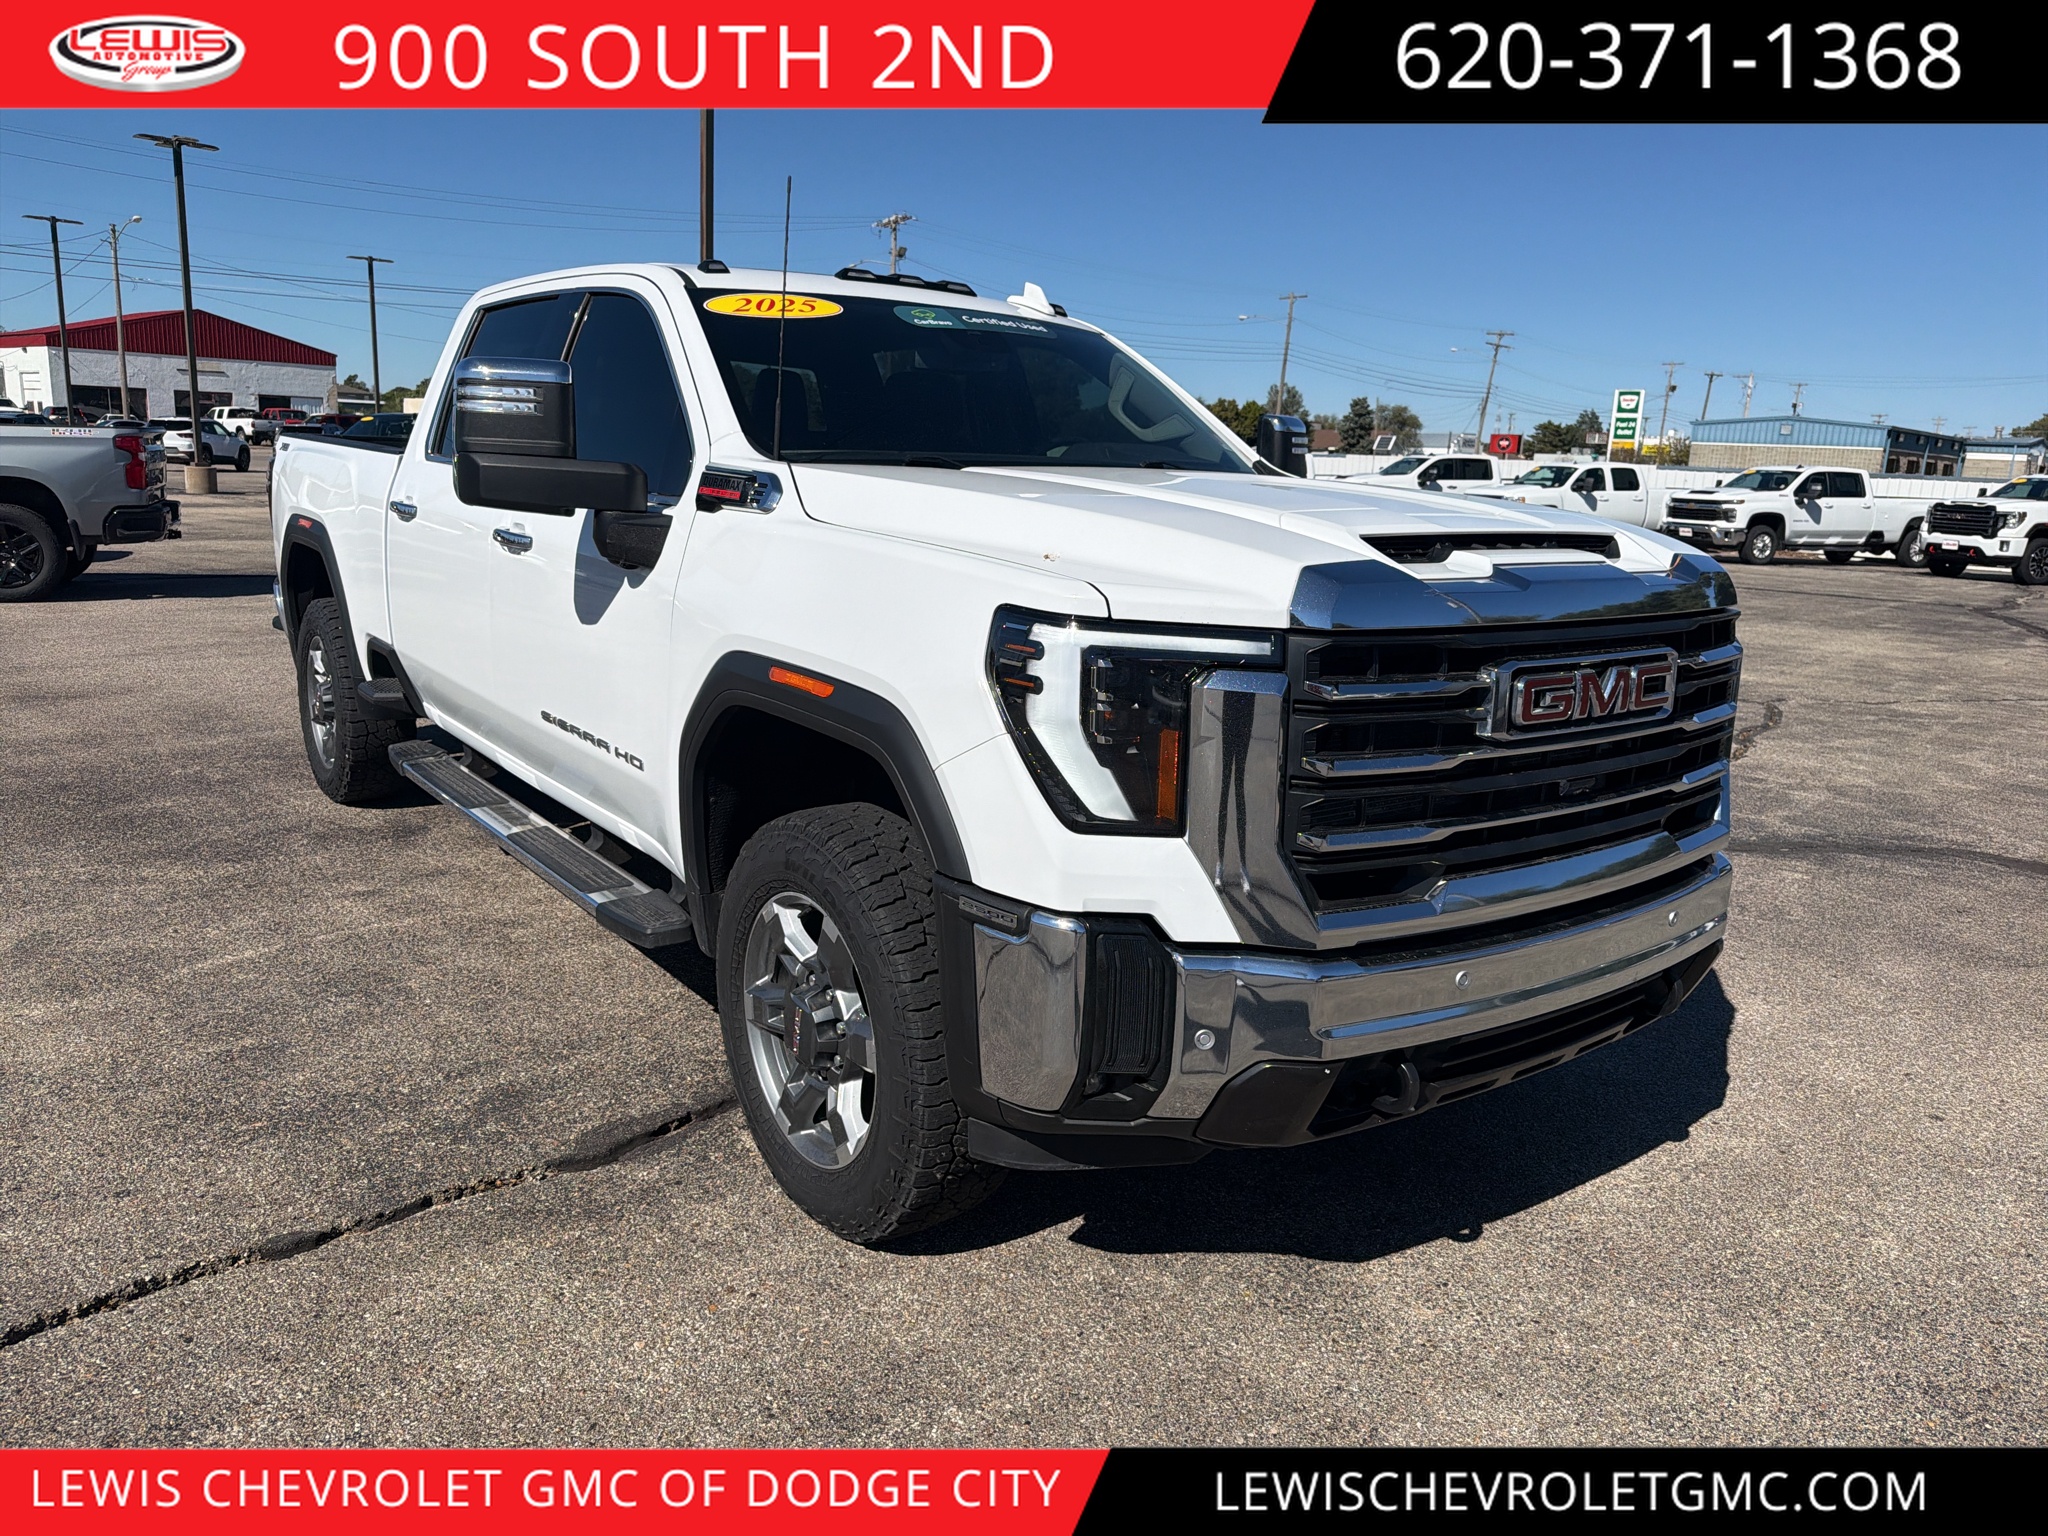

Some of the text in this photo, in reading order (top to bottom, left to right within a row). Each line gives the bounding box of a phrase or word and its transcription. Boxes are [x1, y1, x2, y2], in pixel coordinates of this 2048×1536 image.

[732, 297, 817, 313] 2025
[961, 315, 1049, 333] Certified Used
[702, 475, 742, 491] DURAMAX
[1512, 661, 1672, 726] GMC
[540, 710, 645, 772] SIERRA HD
